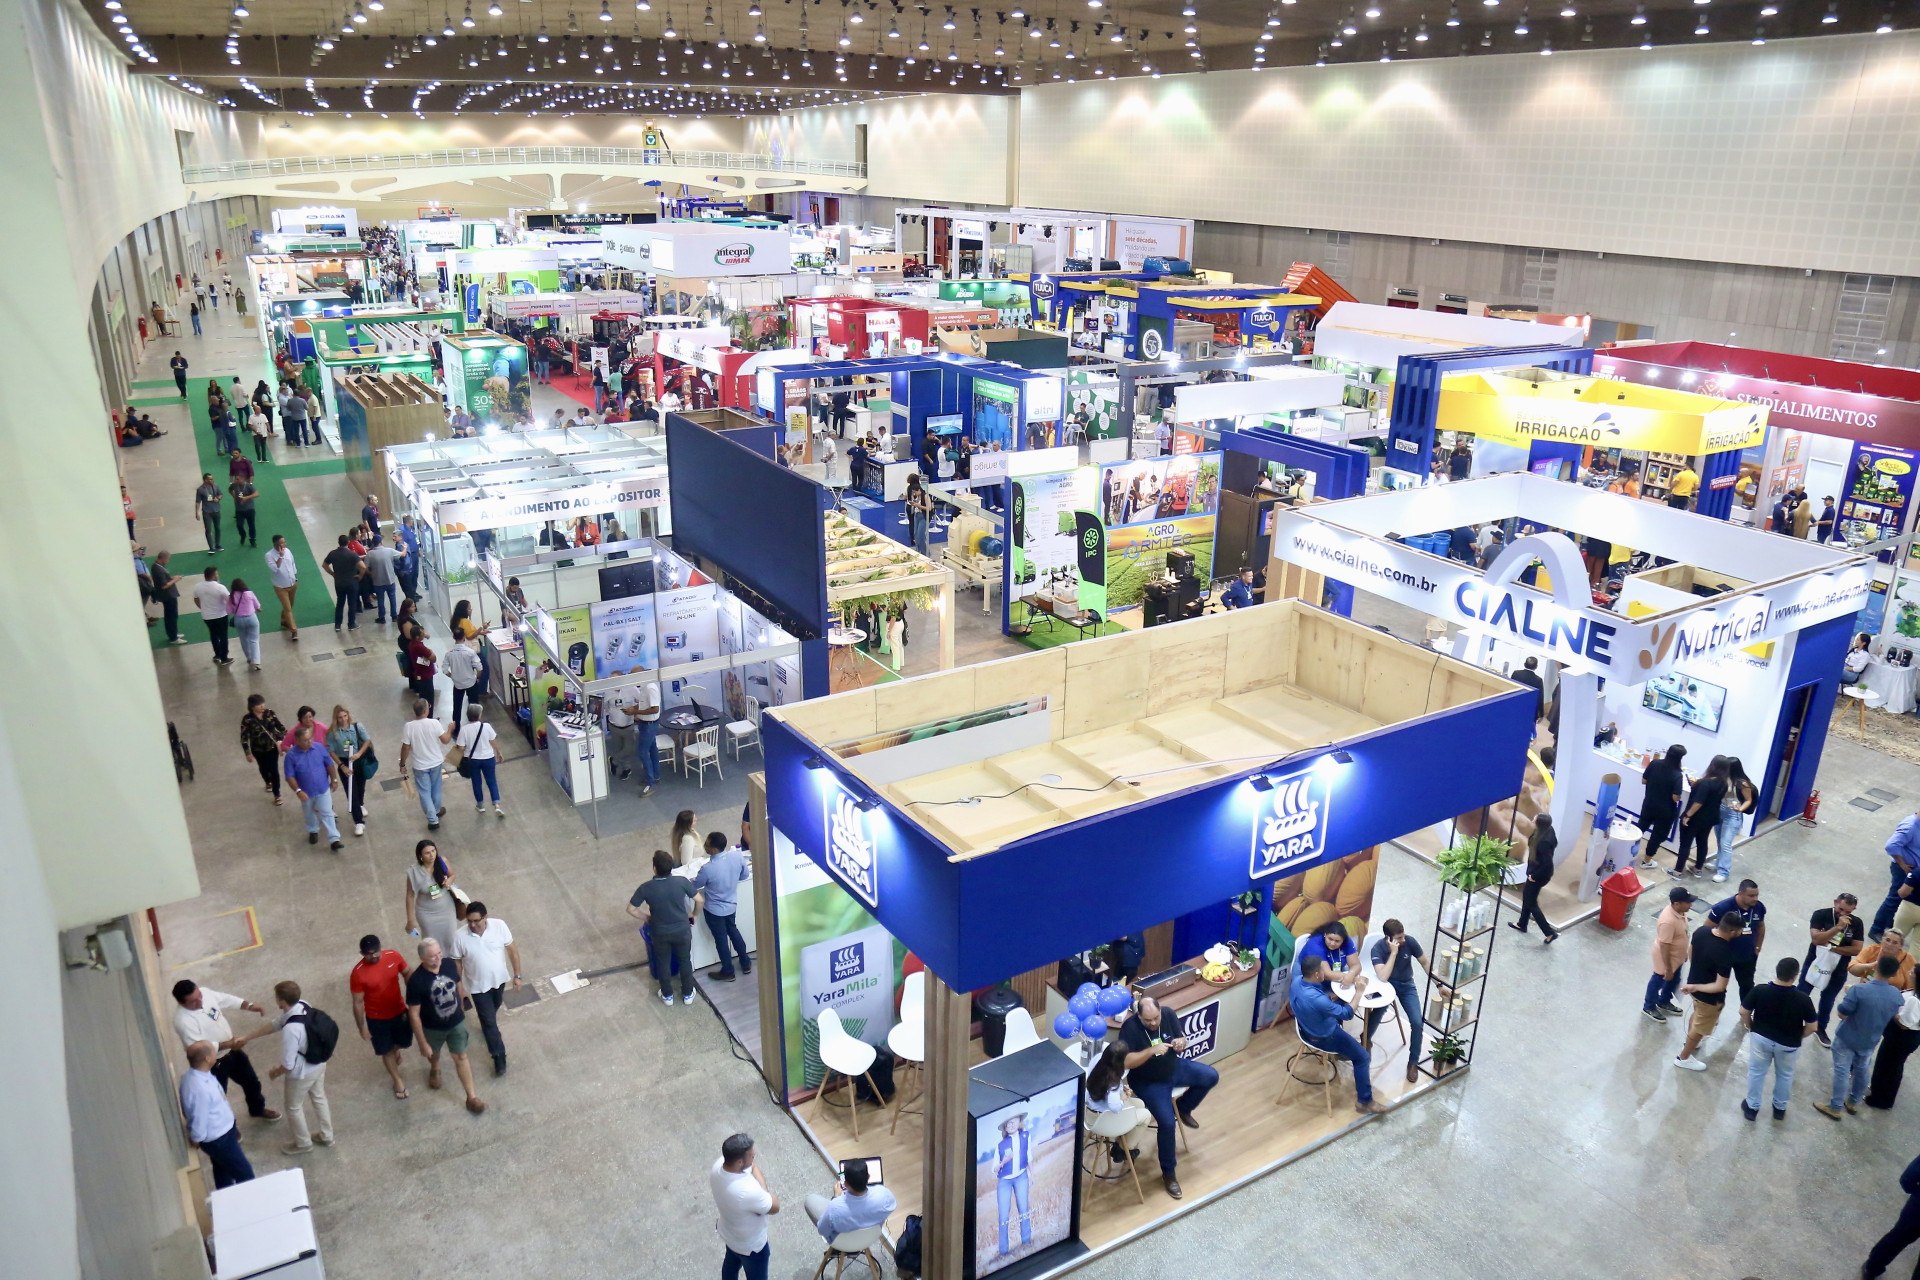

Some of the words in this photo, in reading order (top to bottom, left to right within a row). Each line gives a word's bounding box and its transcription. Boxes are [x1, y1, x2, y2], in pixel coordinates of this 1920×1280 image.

[717, 247, 751, 257] integral
[1515, 421, 1601, 441] IRRIGAÇÃO
[1705, 431, 1751, 450] IRRIGAÇÃO
[573, 497, 590, 508] AO
[1085, 550, 1097, 558] IPC
[1293, 534, 1438, 594] www.cialne.com.br
[1456, 580, 1617, 666] CIALNE
[1261, 833, 1315, 867] YARA
[832, 844, 872, 894] YARA
[834, 966, 861, 979] YARA
[813, 977, 878, 1005] YaraMila
[831, 993, 865, 1010] COMPLEX
